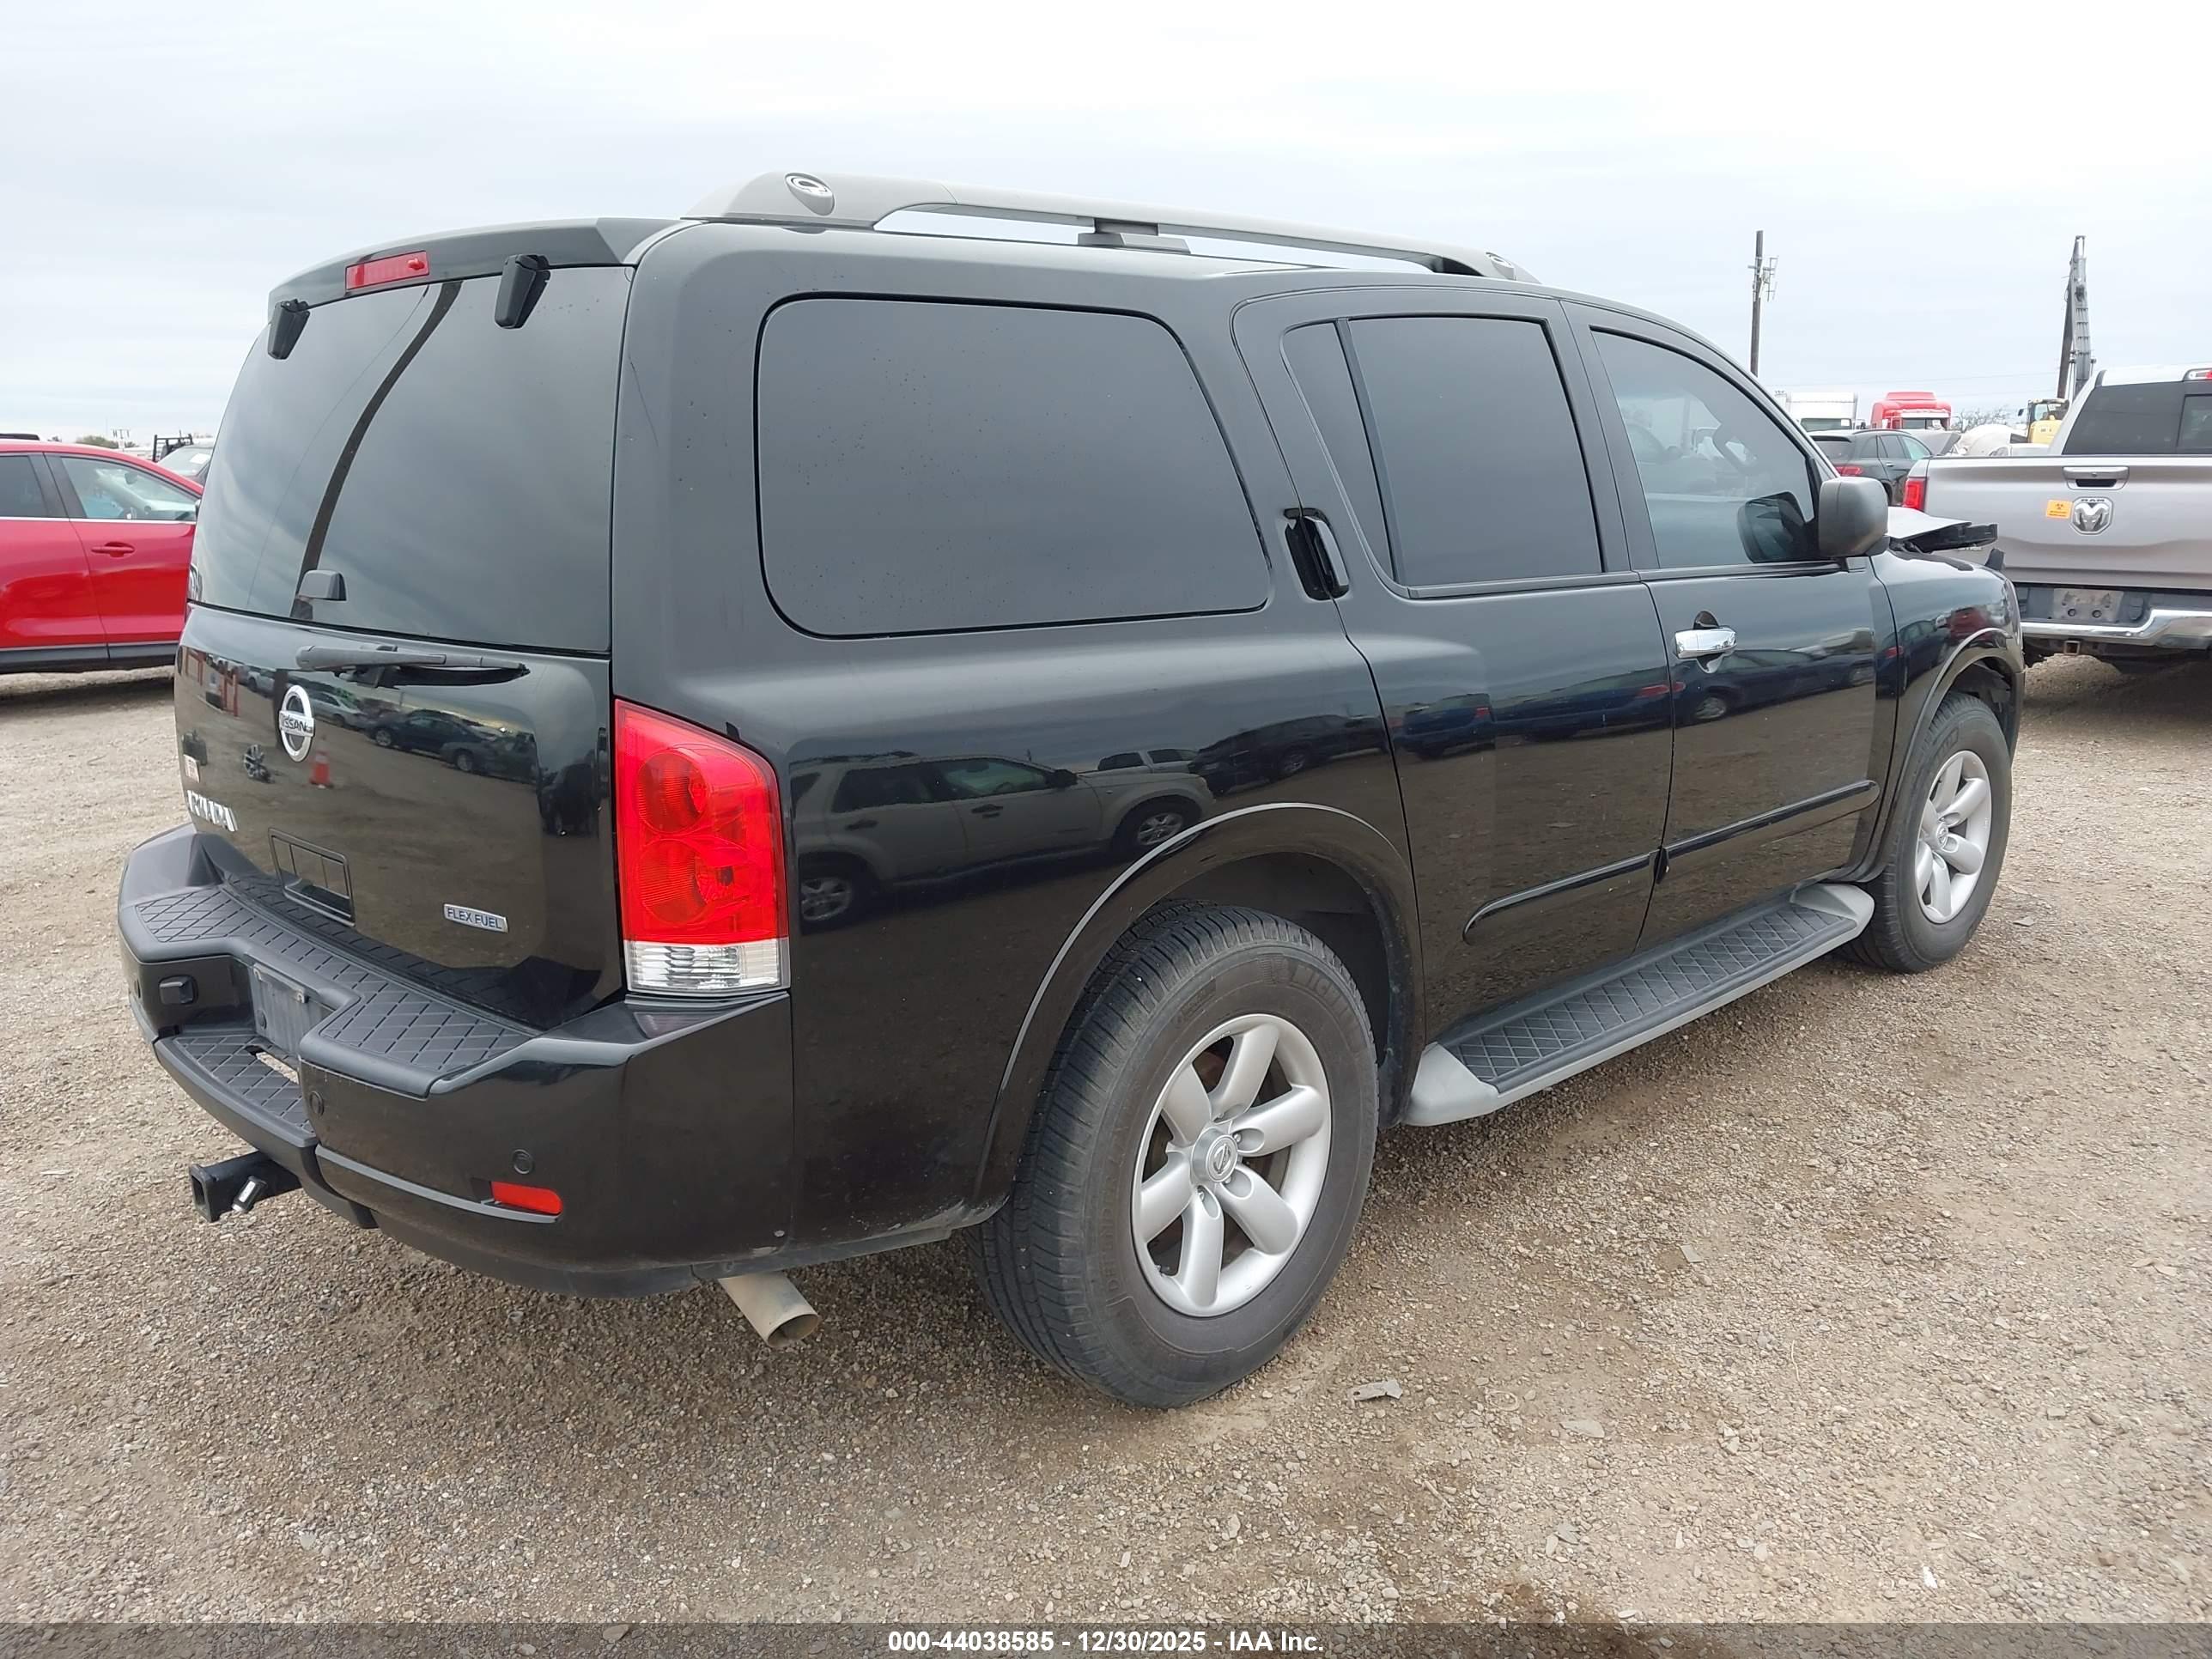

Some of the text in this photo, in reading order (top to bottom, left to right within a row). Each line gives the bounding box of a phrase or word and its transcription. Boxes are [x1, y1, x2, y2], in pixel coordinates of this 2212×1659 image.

[280, 713, 307, 732] NISSAN
[447, 907, 502, 930] FLEX FUEL
